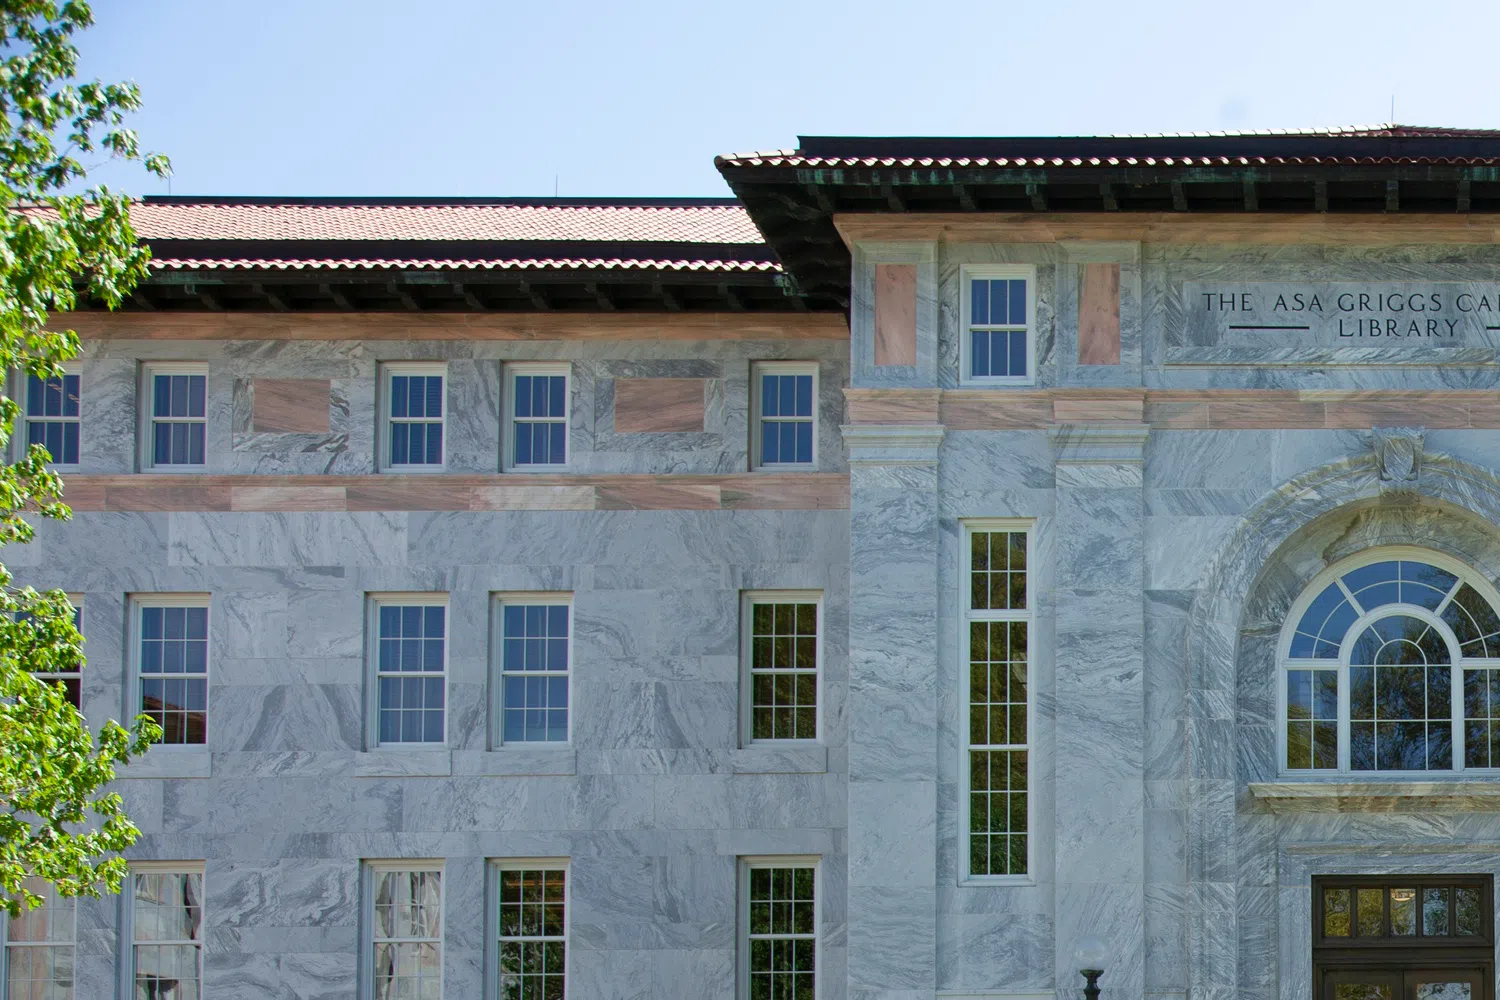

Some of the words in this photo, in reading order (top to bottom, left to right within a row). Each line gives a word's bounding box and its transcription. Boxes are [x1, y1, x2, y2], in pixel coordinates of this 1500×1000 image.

[1201, 293, 1253, 312] THE
[1273, 293, 1324, 312] ASA
[1337, 293, 1442, 312] GRIGGS
[1339, 318, 1459, 338] LIBRARY
